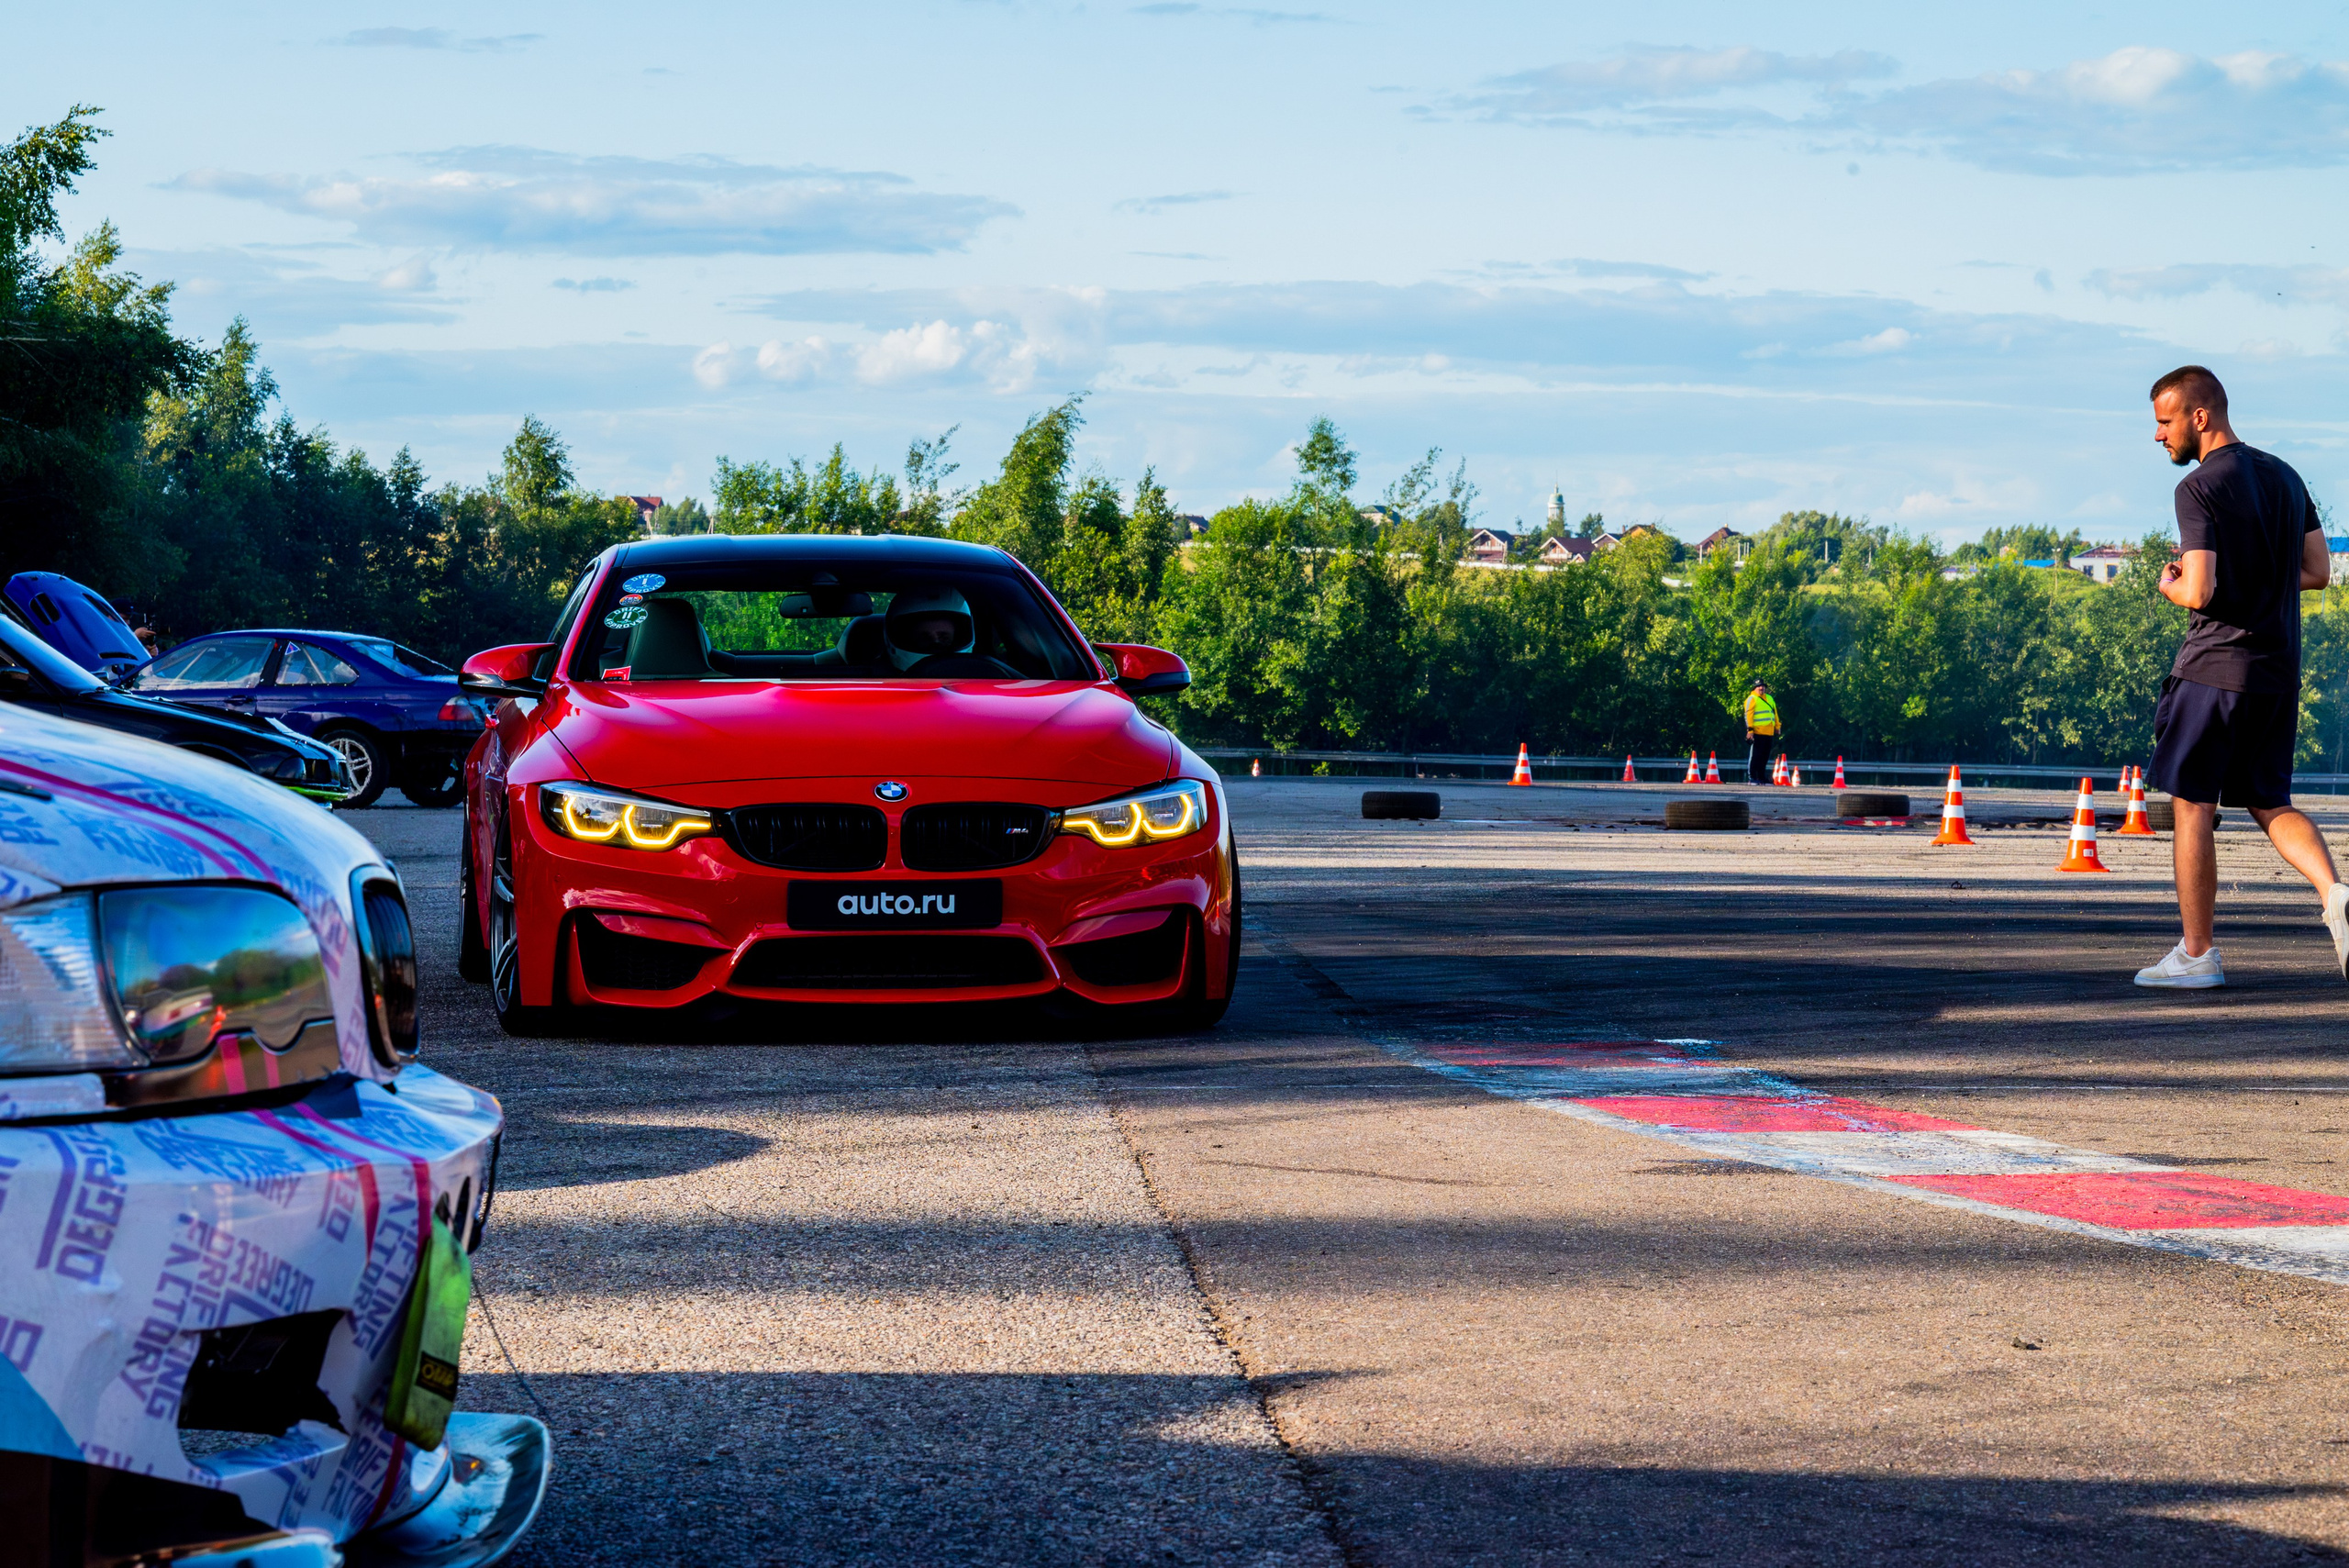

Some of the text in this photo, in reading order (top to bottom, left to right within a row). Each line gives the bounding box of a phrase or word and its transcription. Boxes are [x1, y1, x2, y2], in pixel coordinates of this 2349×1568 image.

[631, 573, 662, 582] DRIFT
[624, 581, 664, 593] APPROVED
[614, 606, 645, 615] DRIFT
[606, 616, 647, 628] APPROVED
[838, 892, 955, 915] auto.ru
[228, 1239, 315, 1314] DEGREE
[120, 1213, 209, 1403] FACTORY
[145, 1228, 235, 1421] DRIFING
